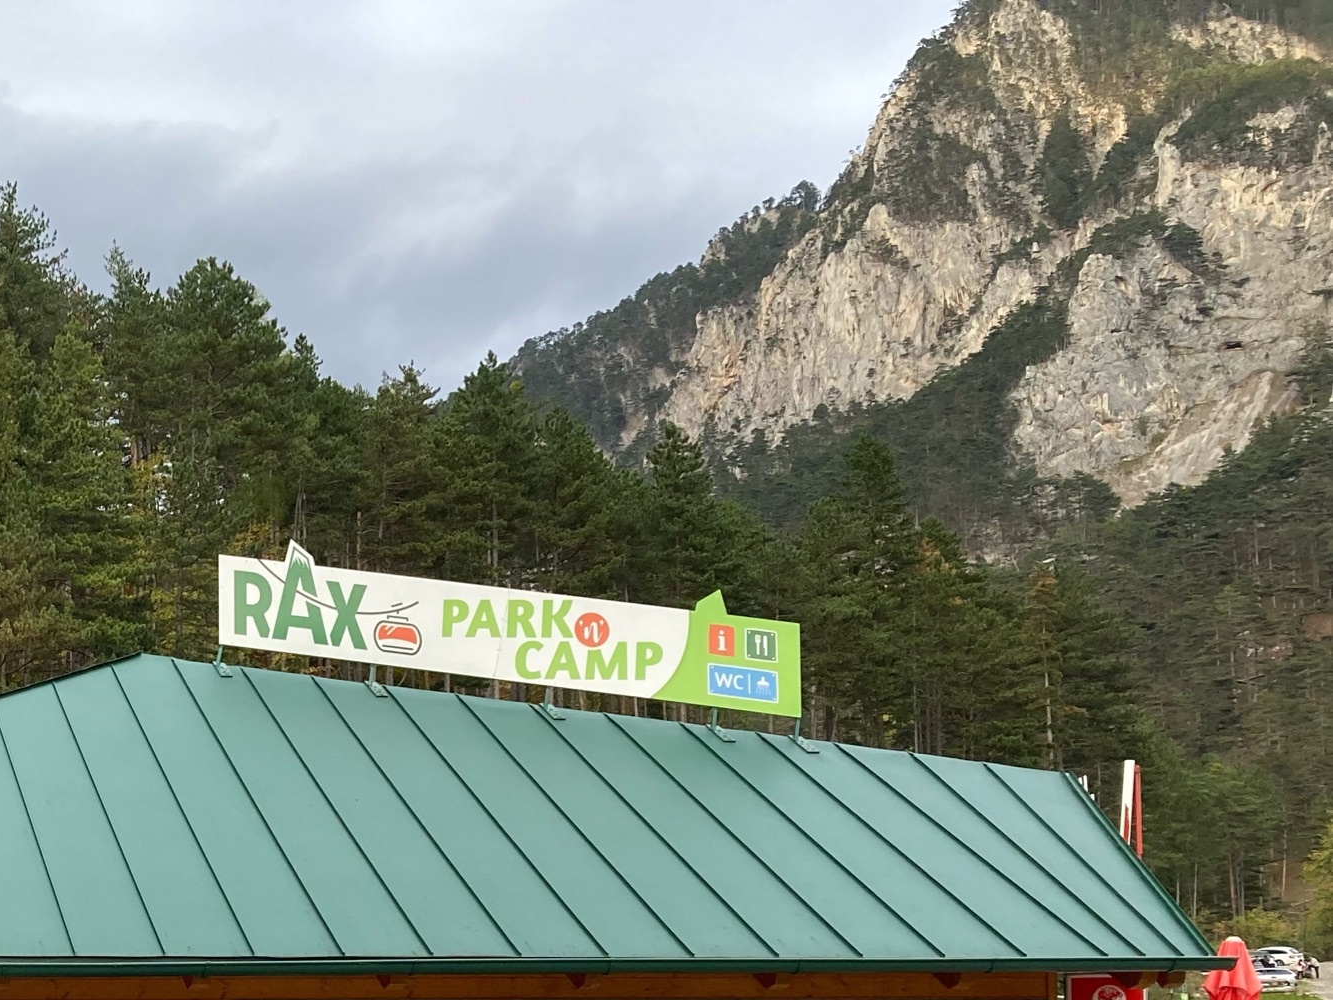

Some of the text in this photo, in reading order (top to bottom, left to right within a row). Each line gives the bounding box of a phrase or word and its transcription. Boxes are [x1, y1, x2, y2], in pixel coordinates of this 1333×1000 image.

[234, 547, 368, 651] RAX
[441, 598, 574, 639] PARK
[515, 640, 664, 681] CAMP
[714, 671, 745, 691] WC
